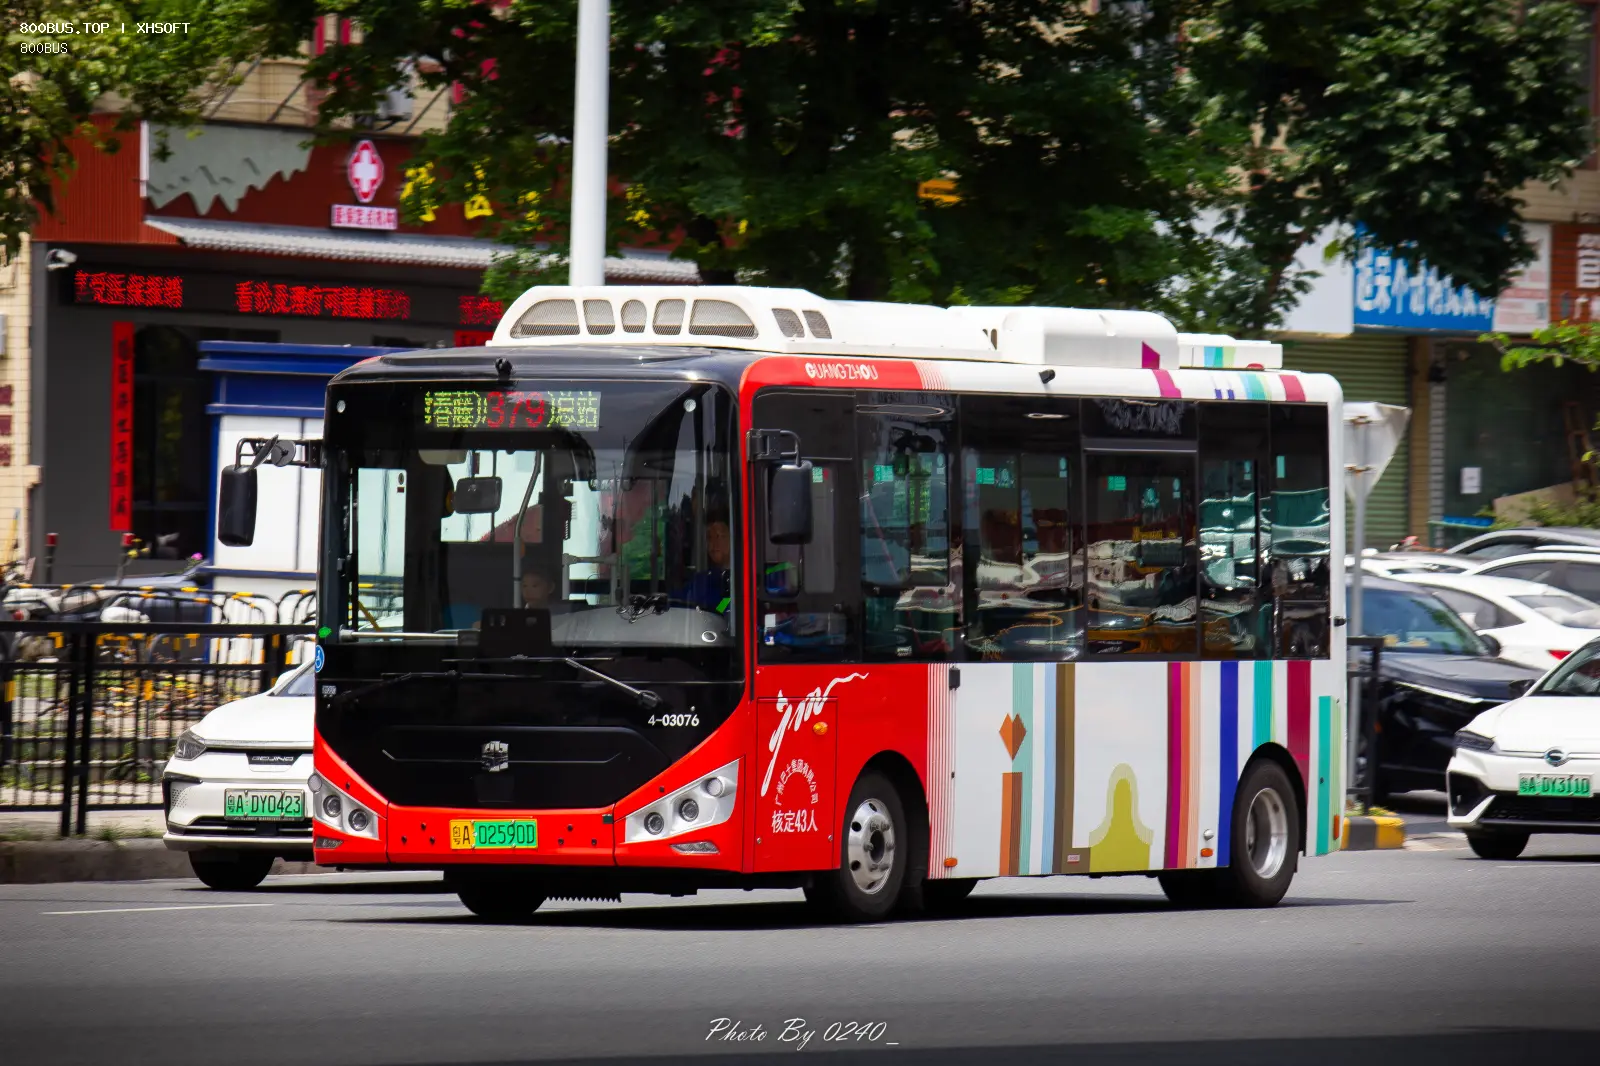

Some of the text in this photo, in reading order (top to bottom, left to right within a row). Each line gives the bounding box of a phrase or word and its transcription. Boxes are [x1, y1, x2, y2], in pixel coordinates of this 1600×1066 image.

[804, 362, 879, 380] GUANGZHOU
[487, 391, 545, 428] 379
[648, 714, 700, 727] 4-03076
[771, 808, 819, 834] 核定43人
